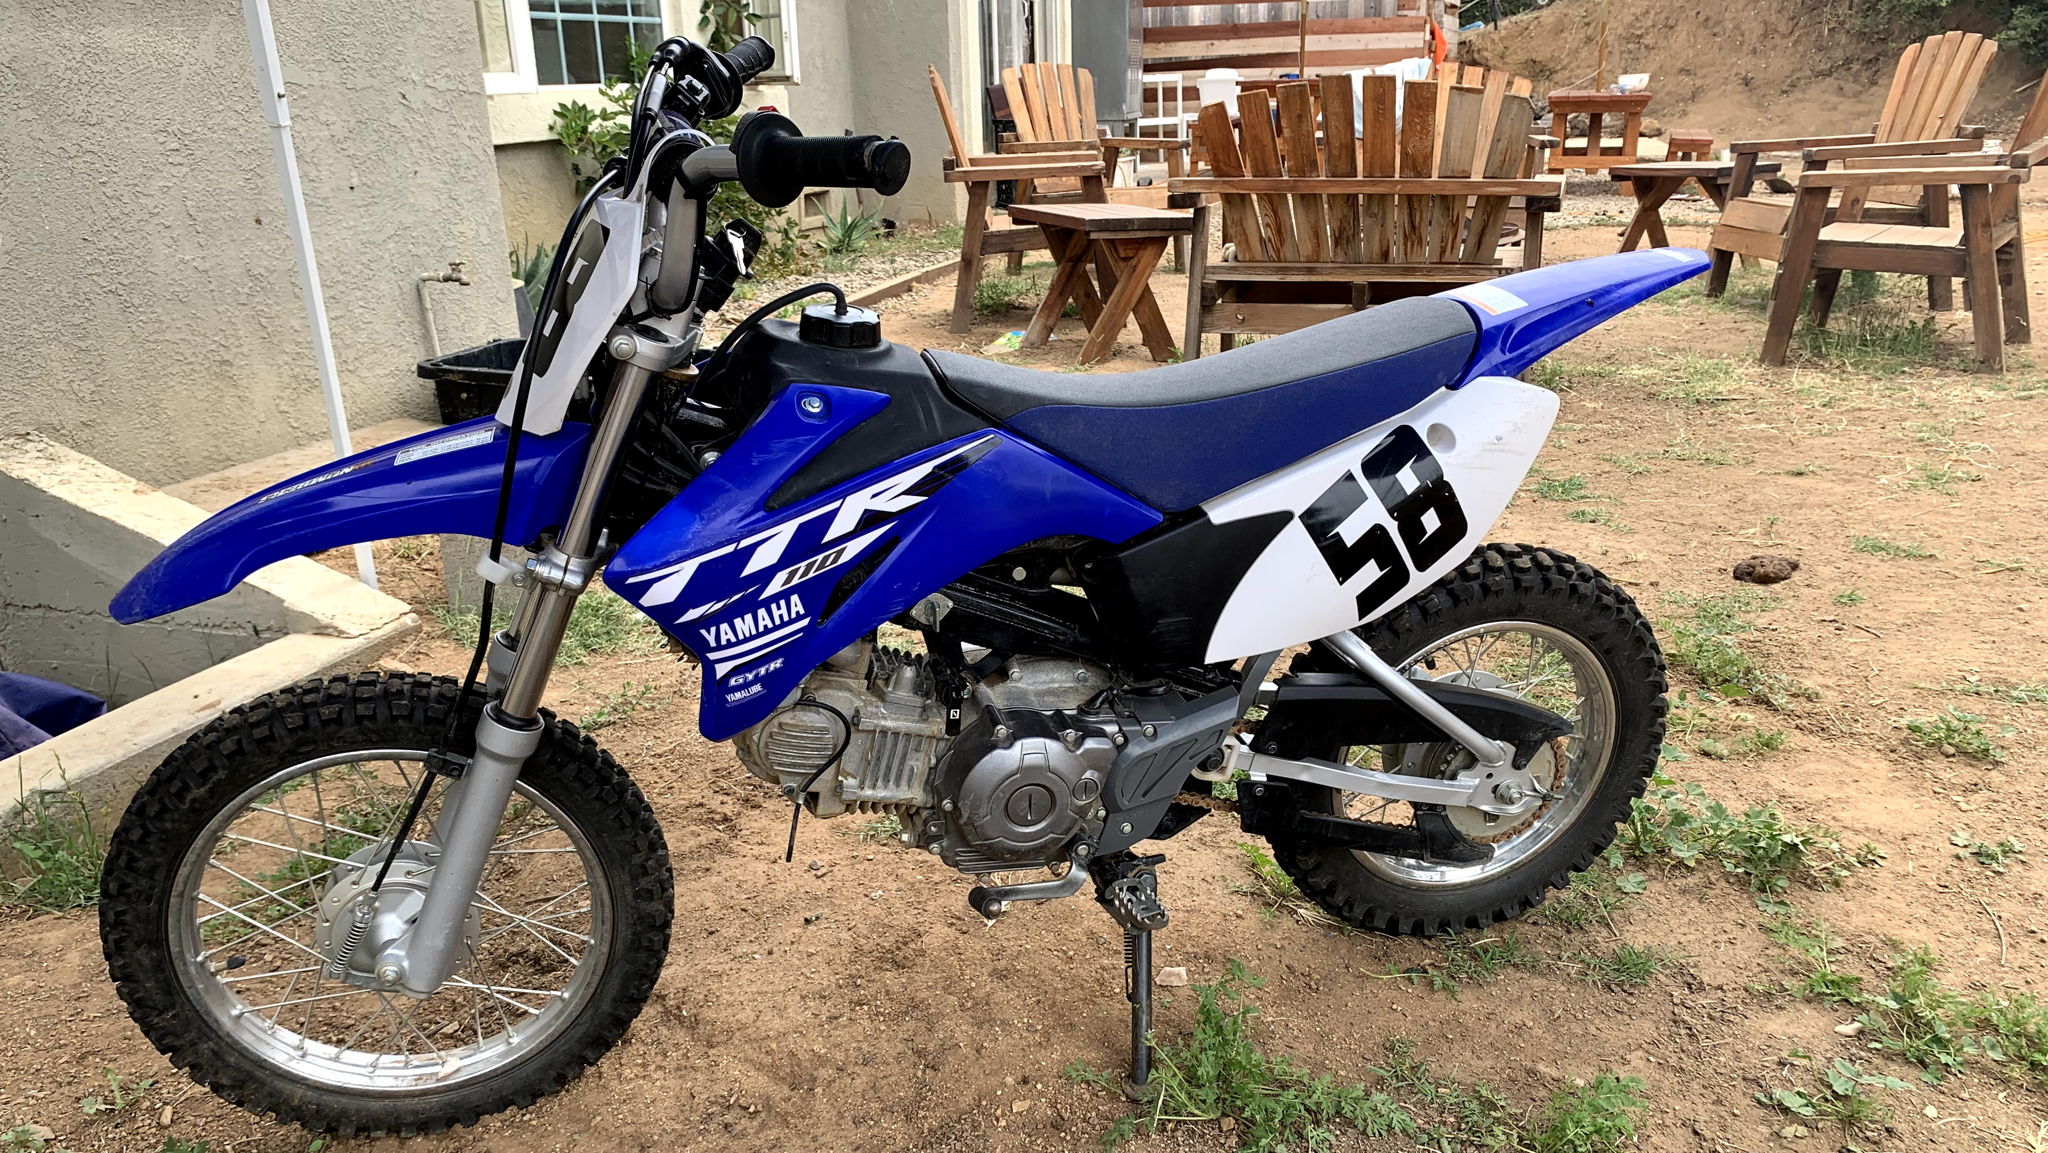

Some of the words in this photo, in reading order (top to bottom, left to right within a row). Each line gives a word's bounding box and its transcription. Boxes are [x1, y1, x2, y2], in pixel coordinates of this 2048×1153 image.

[626, 434, 995, 607] TTR
[1298, 424, 1468, 621] 58
[781, 545, 848, 588] 110
[699, 594, 805, 648] YAMAHA
[724, 683, 764, 703] YAMALUBE
[729, 657, 784, 687] GYTR
